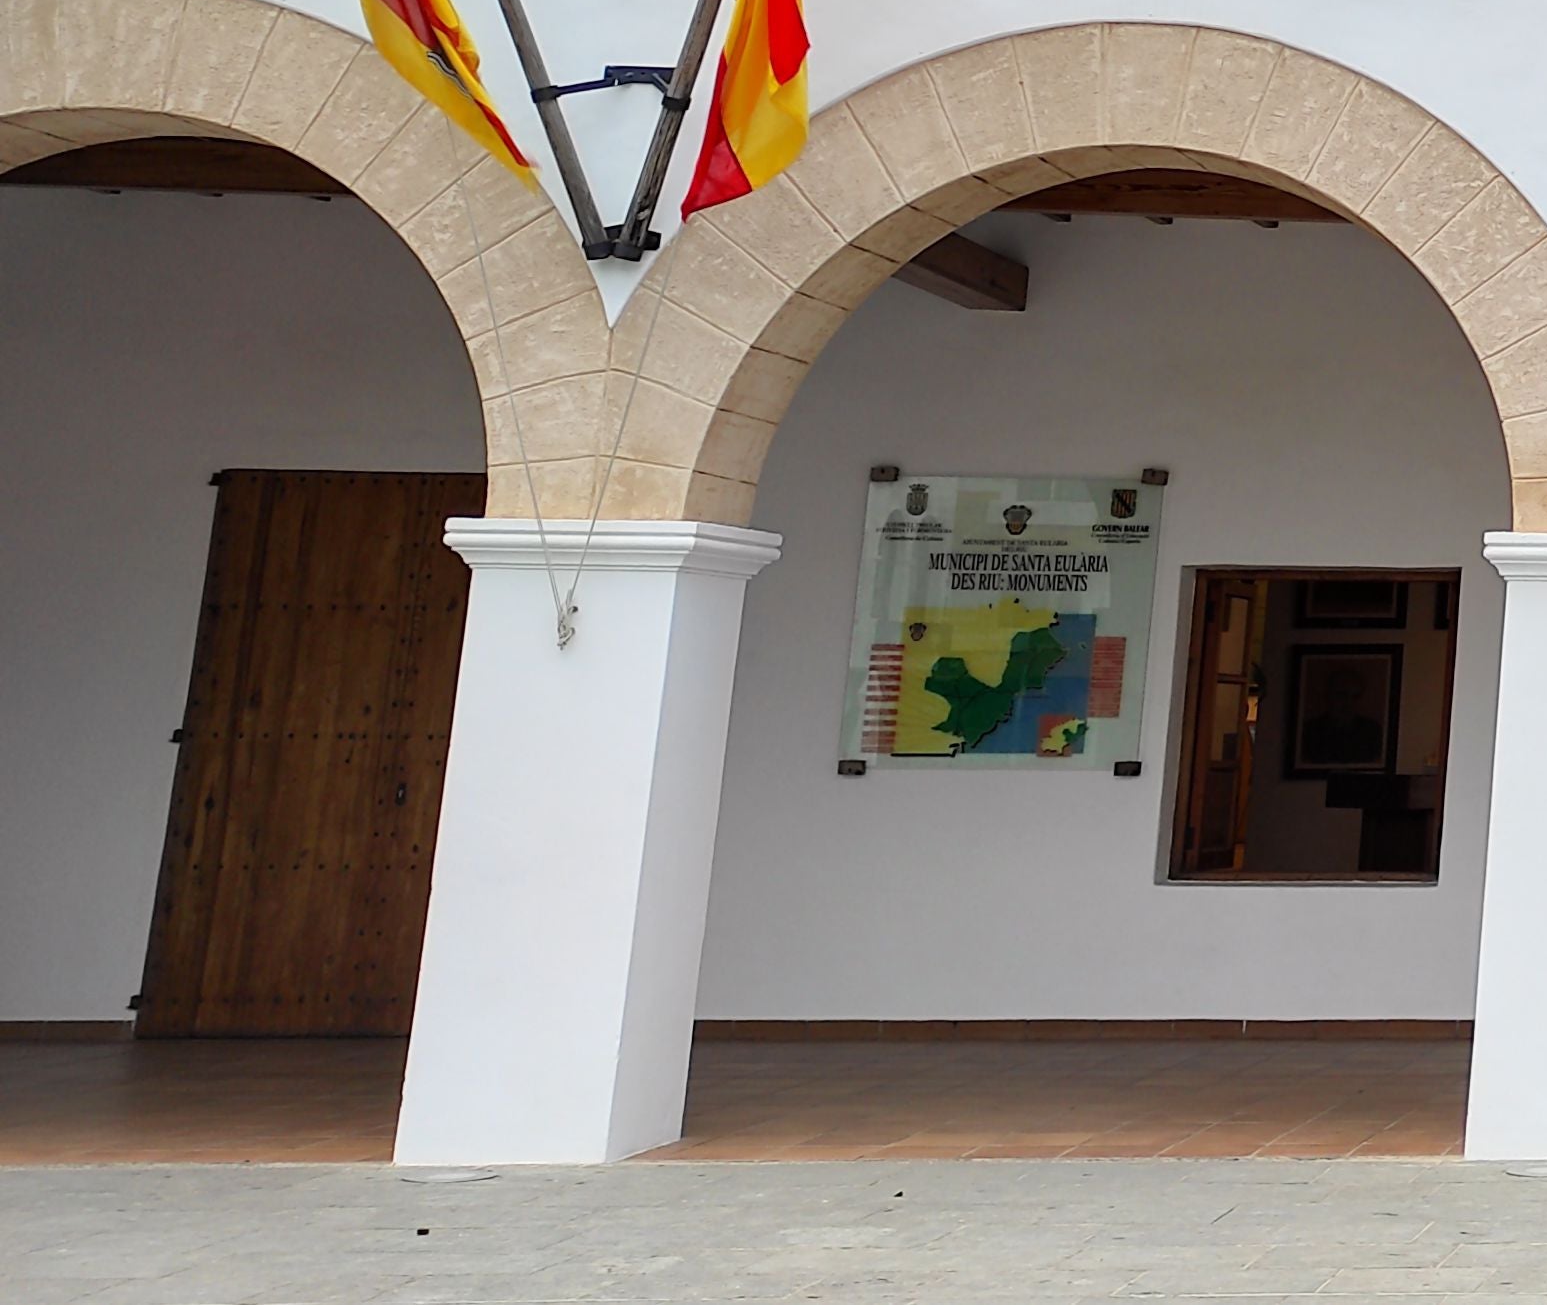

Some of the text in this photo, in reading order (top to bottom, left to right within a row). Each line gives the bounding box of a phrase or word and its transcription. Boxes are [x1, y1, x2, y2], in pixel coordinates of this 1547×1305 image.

[1092, 524, 1150, 533] GOVERN BALEAR
[928, 552, 1109, 573] MUNICIPI DE SANTA EULÀRIA
[951, 573, 1088, 592] DES RIU: MONUMENTS
